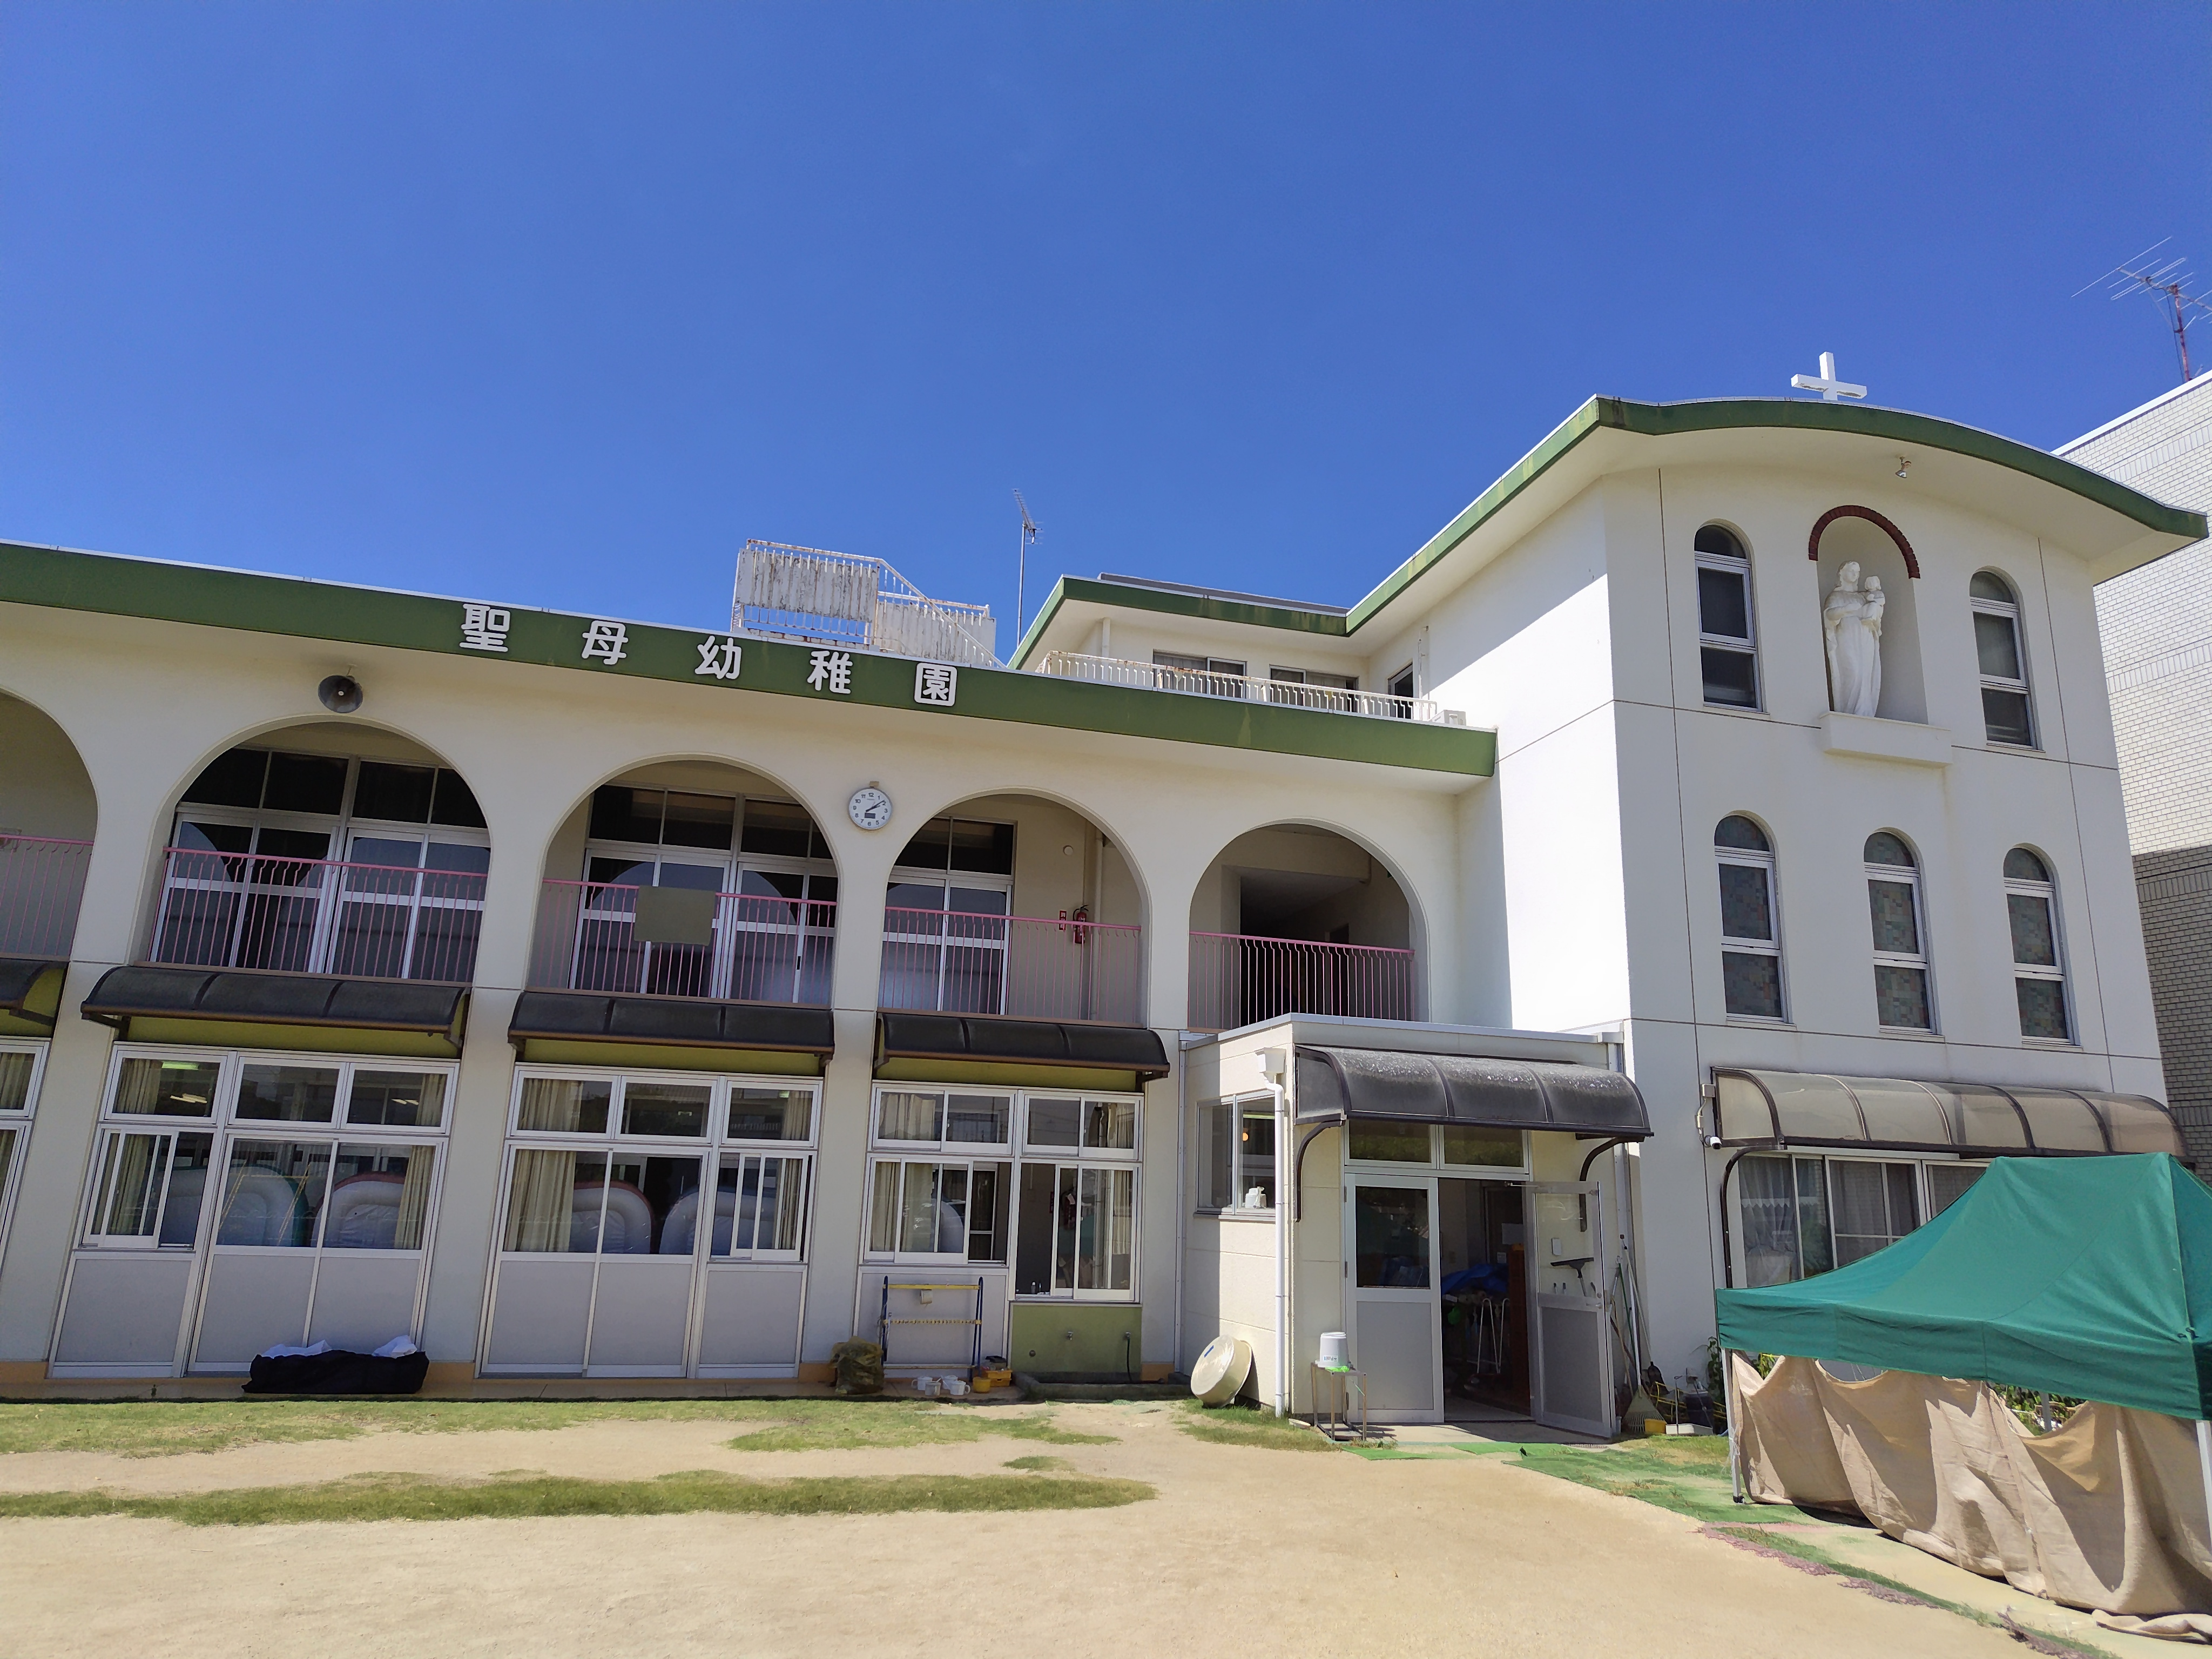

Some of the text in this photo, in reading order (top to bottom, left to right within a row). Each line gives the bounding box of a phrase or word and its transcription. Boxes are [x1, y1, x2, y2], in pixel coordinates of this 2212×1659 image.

[459, 603, 957, 707] 聖母幼稚園
